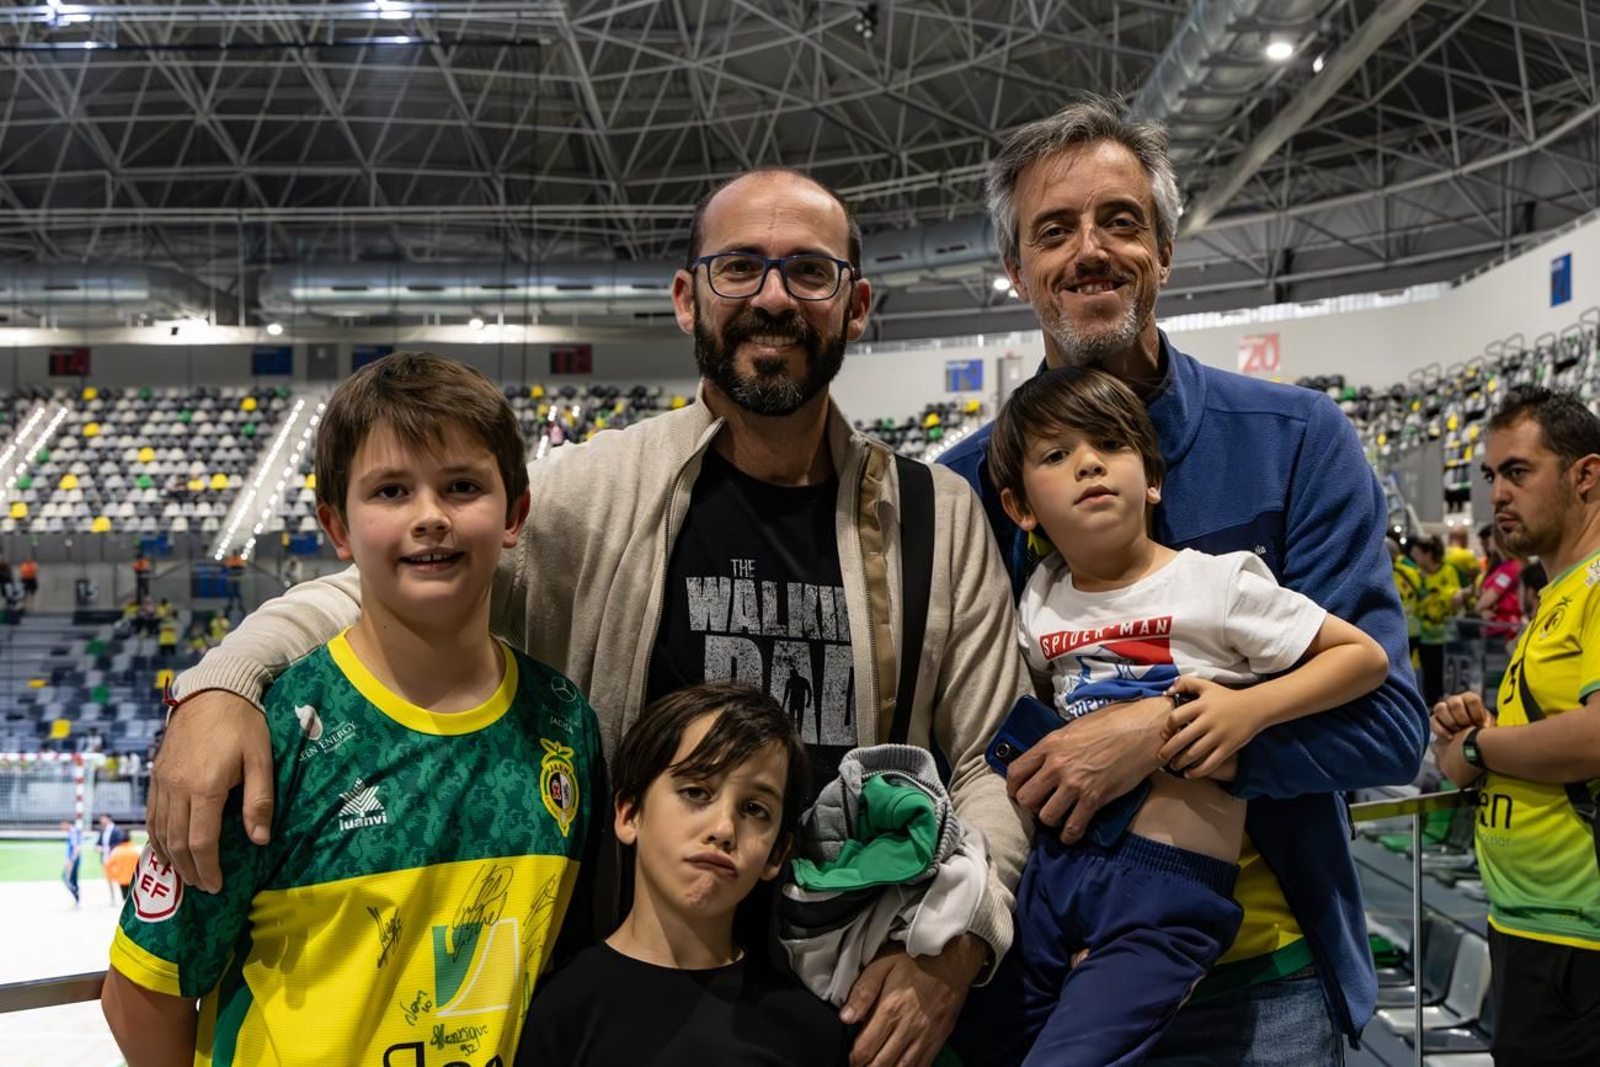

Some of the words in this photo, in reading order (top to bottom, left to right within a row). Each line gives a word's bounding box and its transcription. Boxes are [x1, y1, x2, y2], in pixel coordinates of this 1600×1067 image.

[1241, 334, 1280, 374] 20
[731, 558, 756, 578] THE
[140, 872, 171, 899] EF
